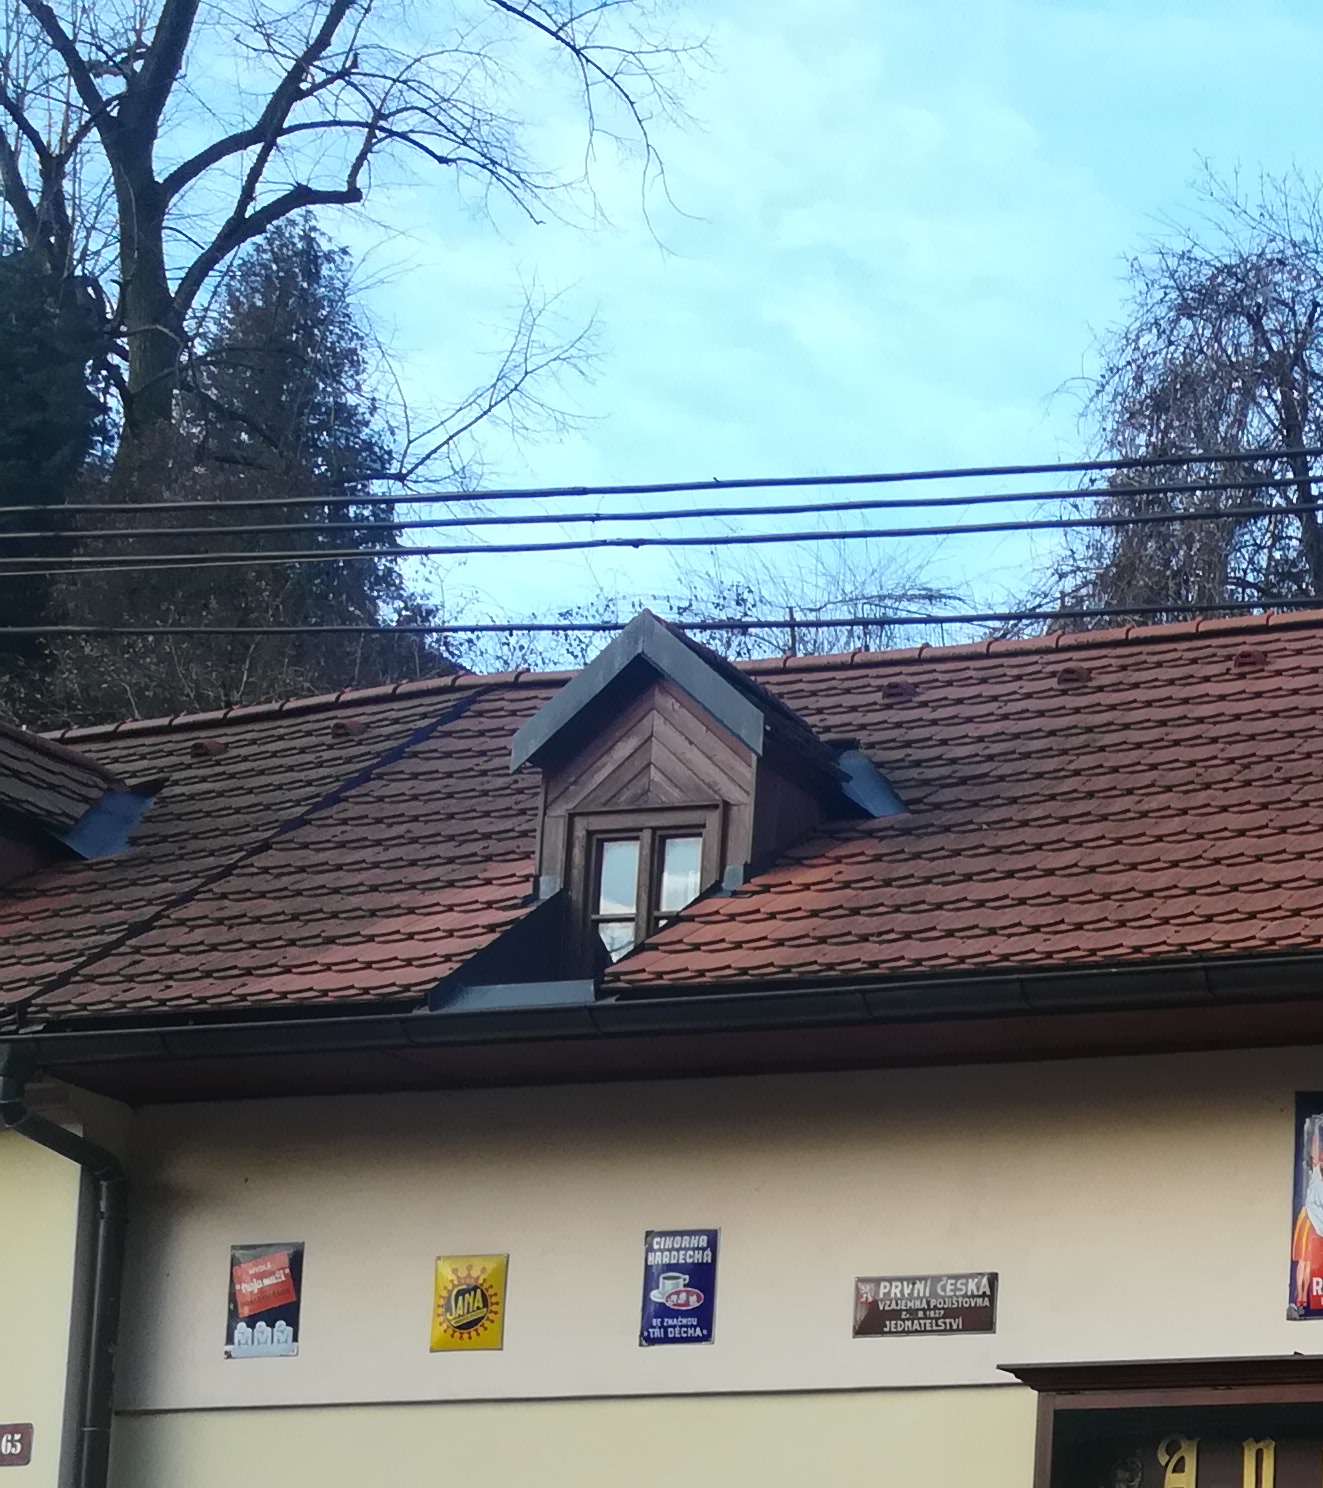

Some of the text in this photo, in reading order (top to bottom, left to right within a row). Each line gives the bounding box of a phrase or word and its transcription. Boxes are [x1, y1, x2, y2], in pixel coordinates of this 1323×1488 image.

[652, 1235, 708, 1250] CIKORKA
[879, 1274, 991, 1299] PRVNÍ ČESKÁ
[446, 1284, 484, 1321] SANA
[883, 1316, 963, 1332] JEDNATELSTVÍ
[0, 1433, 22, 1455] 65
